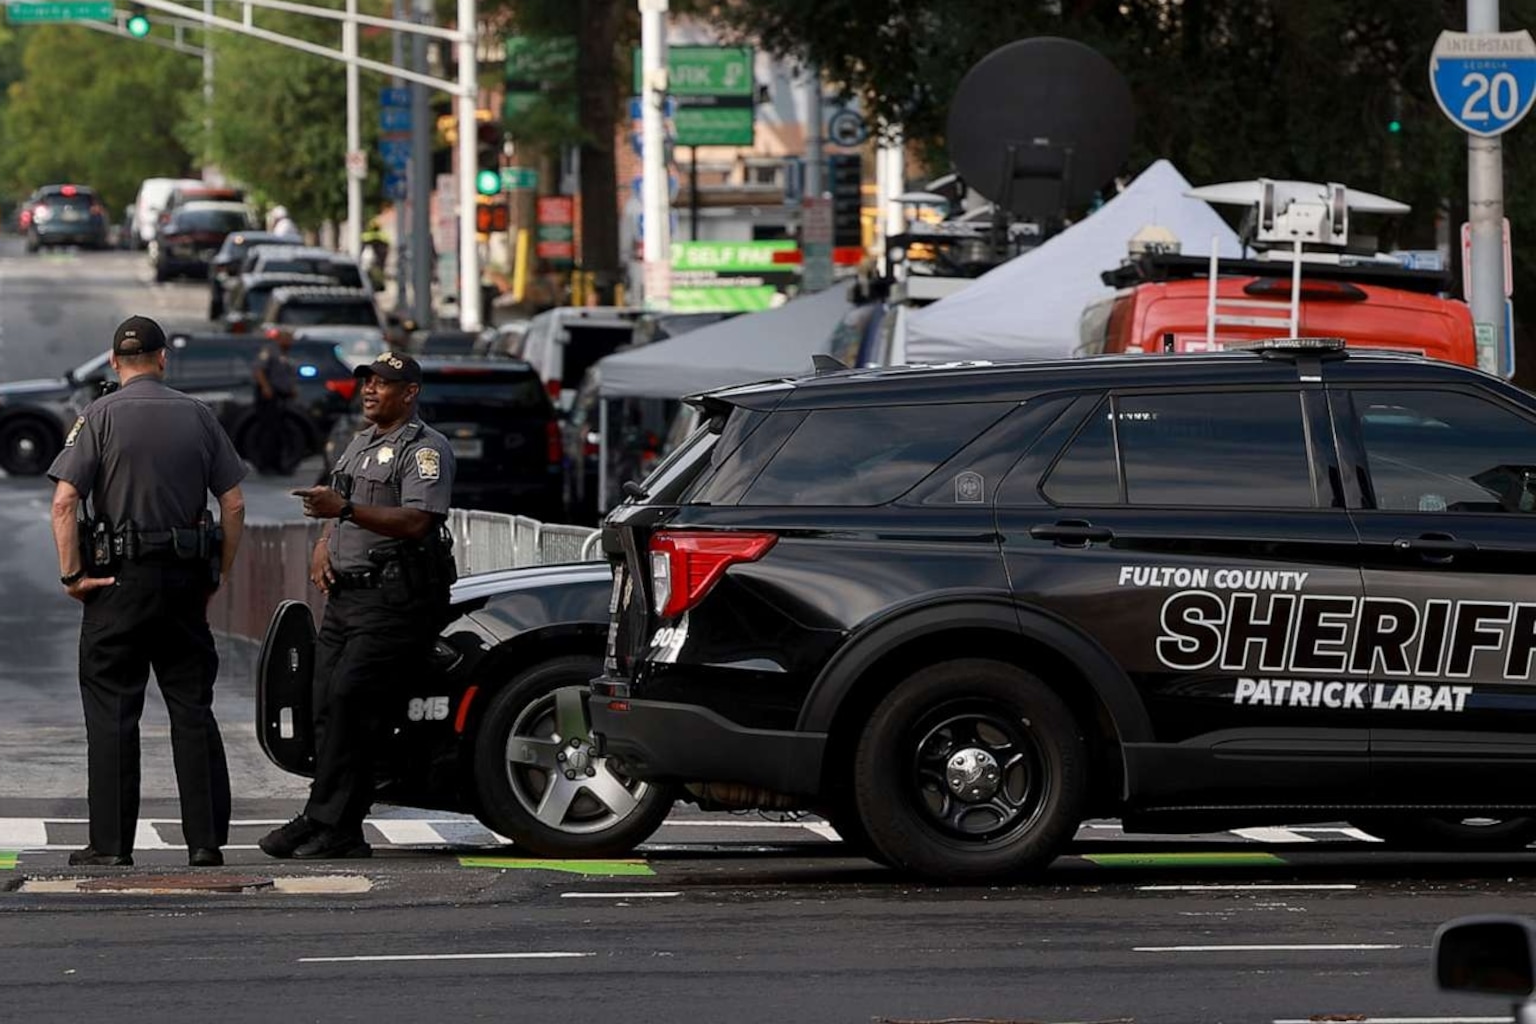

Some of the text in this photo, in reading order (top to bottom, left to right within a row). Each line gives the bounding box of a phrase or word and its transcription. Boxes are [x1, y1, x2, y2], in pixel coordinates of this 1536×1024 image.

[1447, 37, 1525, 53] INTERSTATE
[1462, 72, 1519, 121] 20
[1118, 566, 1309, 591] FULTON COUNTY
[650, 626, 687, 649] 905
[1155, 590, 1536, 680] SHERIFF
[1233, 678, 1473, 711] PATRICK LABAT
[407, 696, 450, 722] 815
